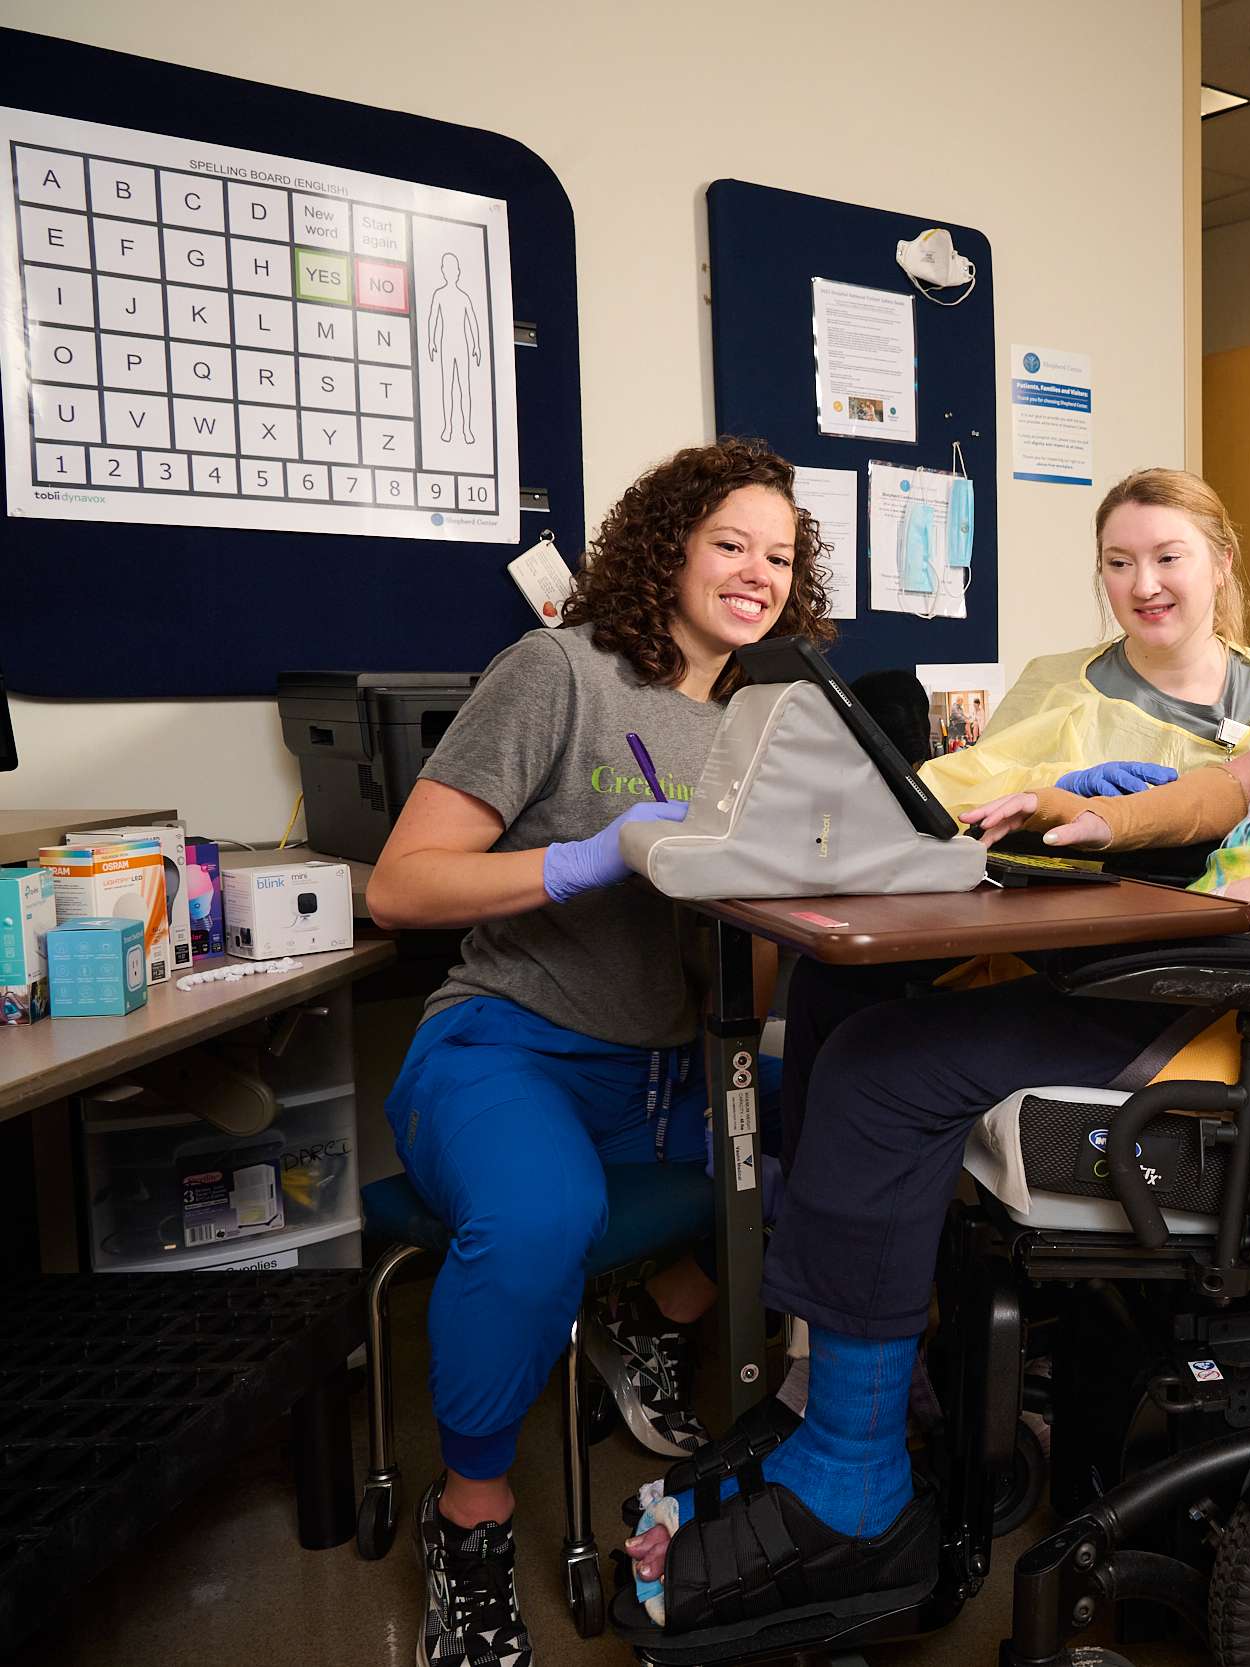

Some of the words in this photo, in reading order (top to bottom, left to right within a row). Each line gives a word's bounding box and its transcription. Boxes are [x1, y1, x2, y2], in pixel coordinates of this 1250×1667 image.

[43, 170, 61, 188] A
[189, 160, 247, 178] SPELLING
[250, 170, 291, 185] BOARD
[294, 177, 349, 196] (ENGLISH)
[116, 181, 131, 199] B
[185, 193, 200, 210] C
[252, 203, 266, 220] D
[304, 205, 334, 222] New
[305, 224, 338, 240] word
[361, 216, 393, 233] Start
[48, 228, 64, 247] E
[362, 236, 398, 250] again
[121, 239, 134, 256] F
[188, 250, 204, 267] G
[255, 258, 269, 276] H
[306, 267, 340, 285] YES
[371, 279, 394, 295] NO
[126, 298, 136, 314] J
[192, 306, 207, 323] K
[259, 314, 270, 331] L
[318, 322, 334, 339] M
[378, 330, 390, 347] N
[54, 347, 72, 364] O
[127, 354, 142, 371] P
[193, 362, 211, 380] Q
[260, 369, 274, 386] R
[322, 376, 334, 392] S
[380, 383, 392, 398] T
[59, 405, 74, 422] U
[129, 411, 145, 428] V
[194, 417, 215, 434] W
[262, 424, 276, 440] X
[323, 429, 336, 445] Y
[383, 435, 395, 450] Z
[56, 456, 67, 473] 1
[109, 459, 121, 476] 2
[160, 463, 171, 480] 3
[209, 468, 221, 483] 4
[257, 471, 267, 487] 5
[303, 474, 313, 490] 6
[347, 477, 357, 493] 7
[390, 481, 400, 496] 8
[431, 484, 441, 499] 9
[34, 491, 60, 500] tobii
[61, 492, 106, 504] dynavox
[468, 487, 487, 502] 10
[101, 860, 129, 872] OSRAM
[257, 877, 285, 890] blink
